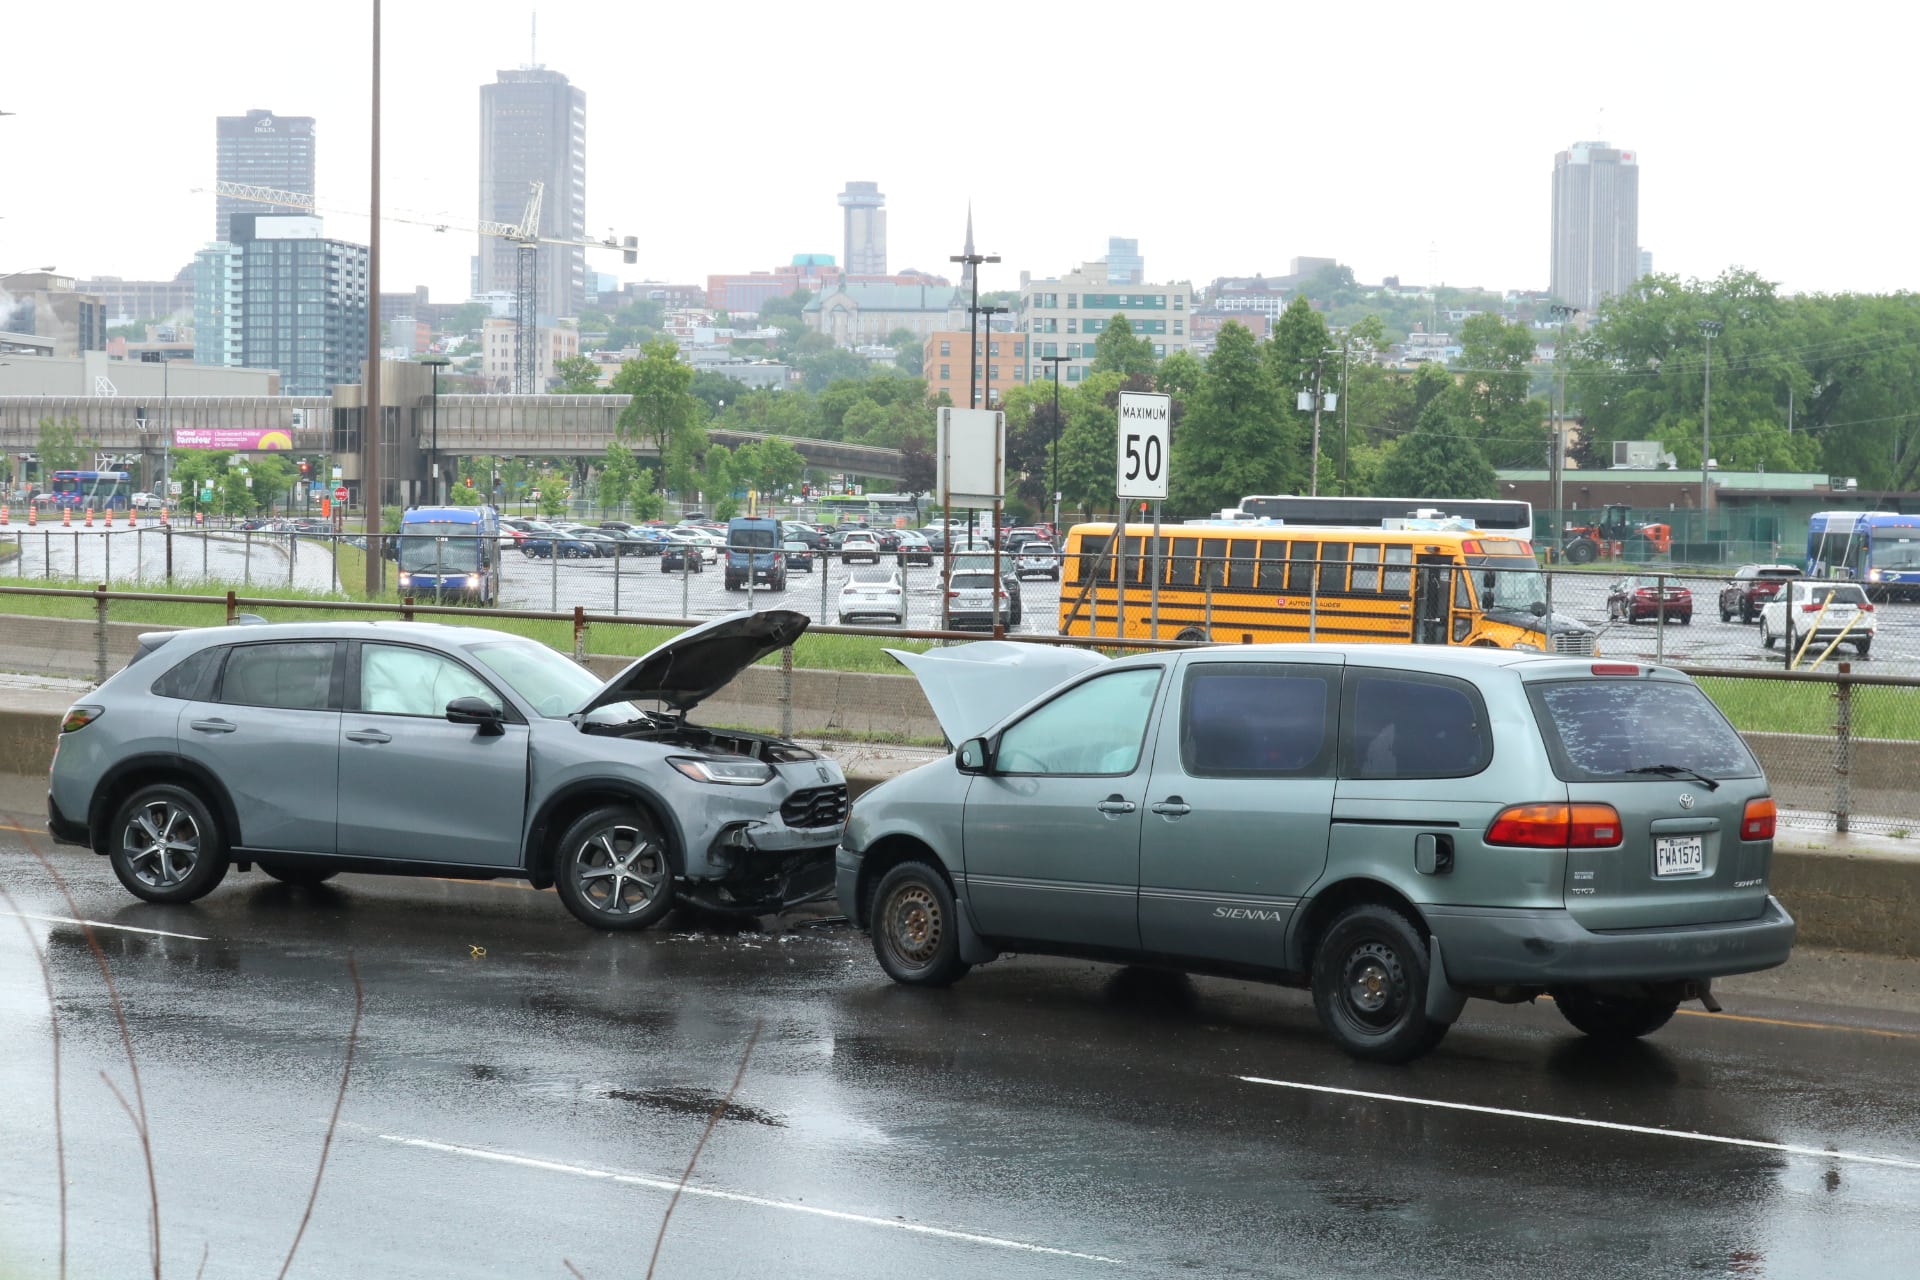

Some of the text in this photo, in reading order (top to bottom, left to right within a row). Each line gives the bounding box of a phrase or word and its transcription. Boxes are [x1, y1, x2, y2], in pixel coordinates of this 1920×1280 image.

[1122, 406, 1166, 420] MAXIMUM
[1125, 434, 1162, 482] 50
[1659, 845, 1701, 866] FWA1573
[1212, 906, 1281, 921] SIENNA
